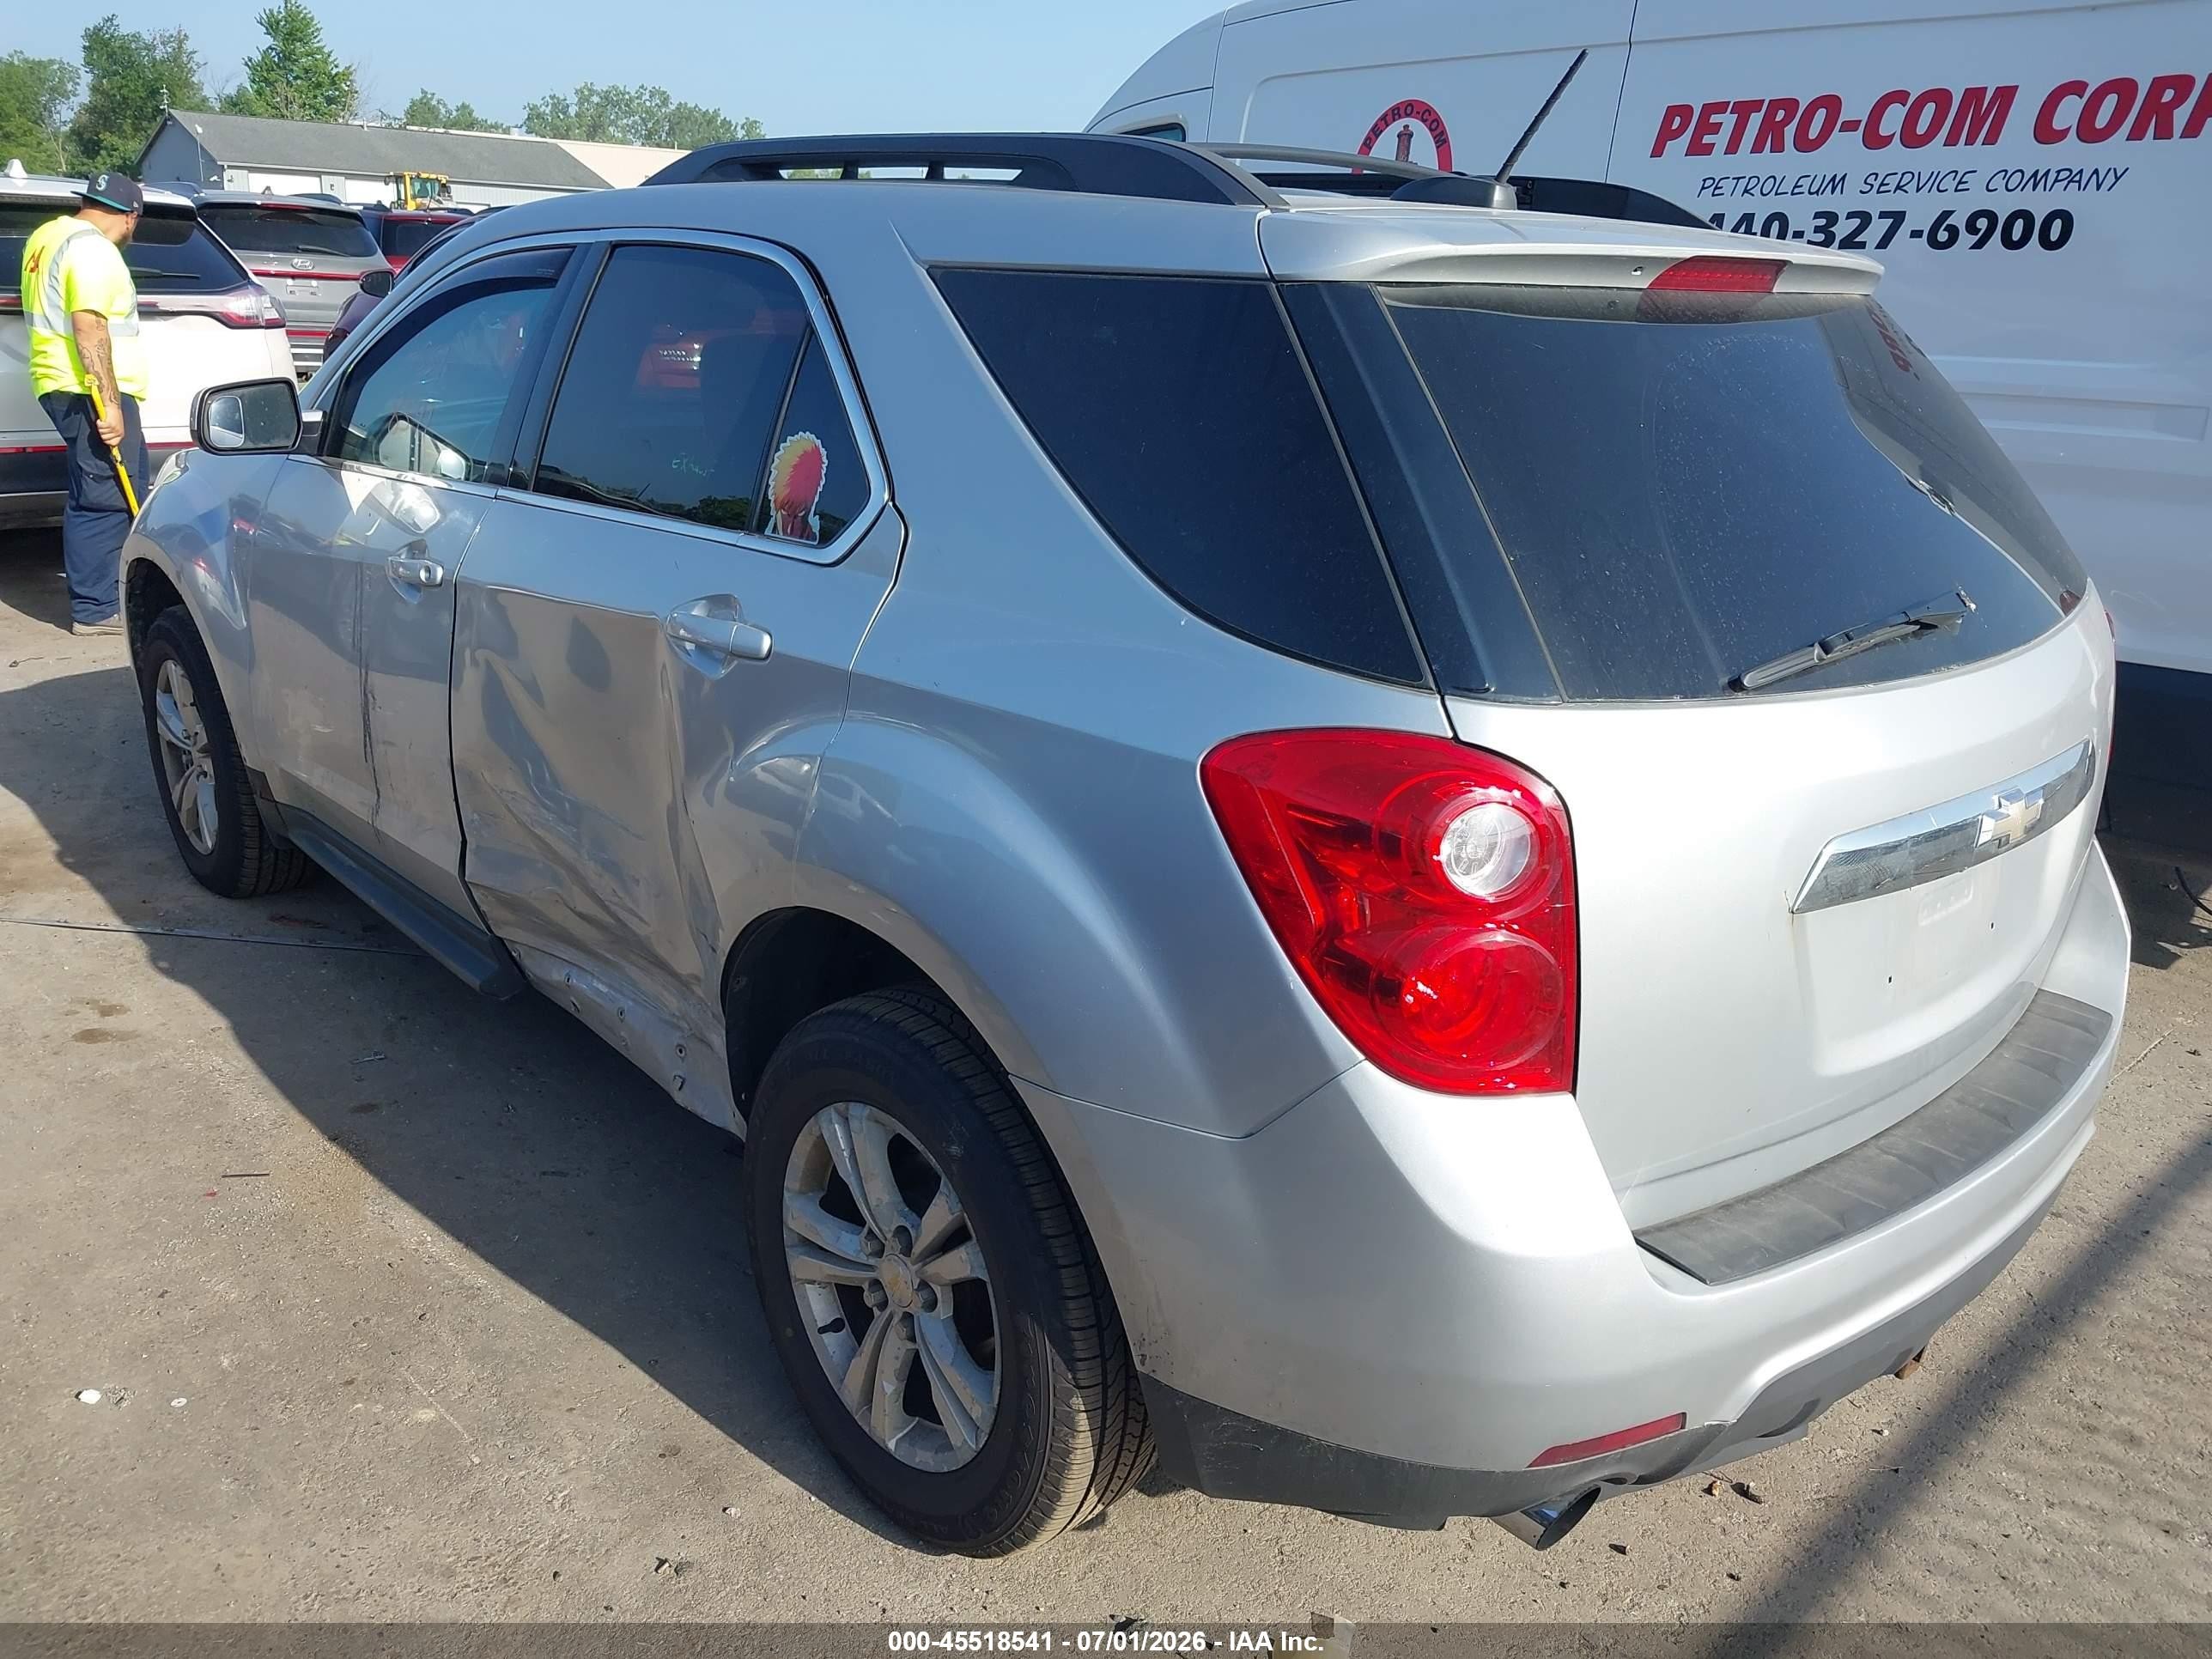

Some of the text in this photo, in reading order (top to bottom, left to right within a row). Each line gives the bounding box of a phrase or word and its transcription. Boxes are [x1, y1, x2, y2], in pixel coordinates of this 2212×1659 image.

[1364, 102, 1447, 149] PETRO-COM
[1650, 85, 2020, 158] PETRO-COM
[1697, 167, 2130, 198] PETROLEUM SERVICE COMPANY
